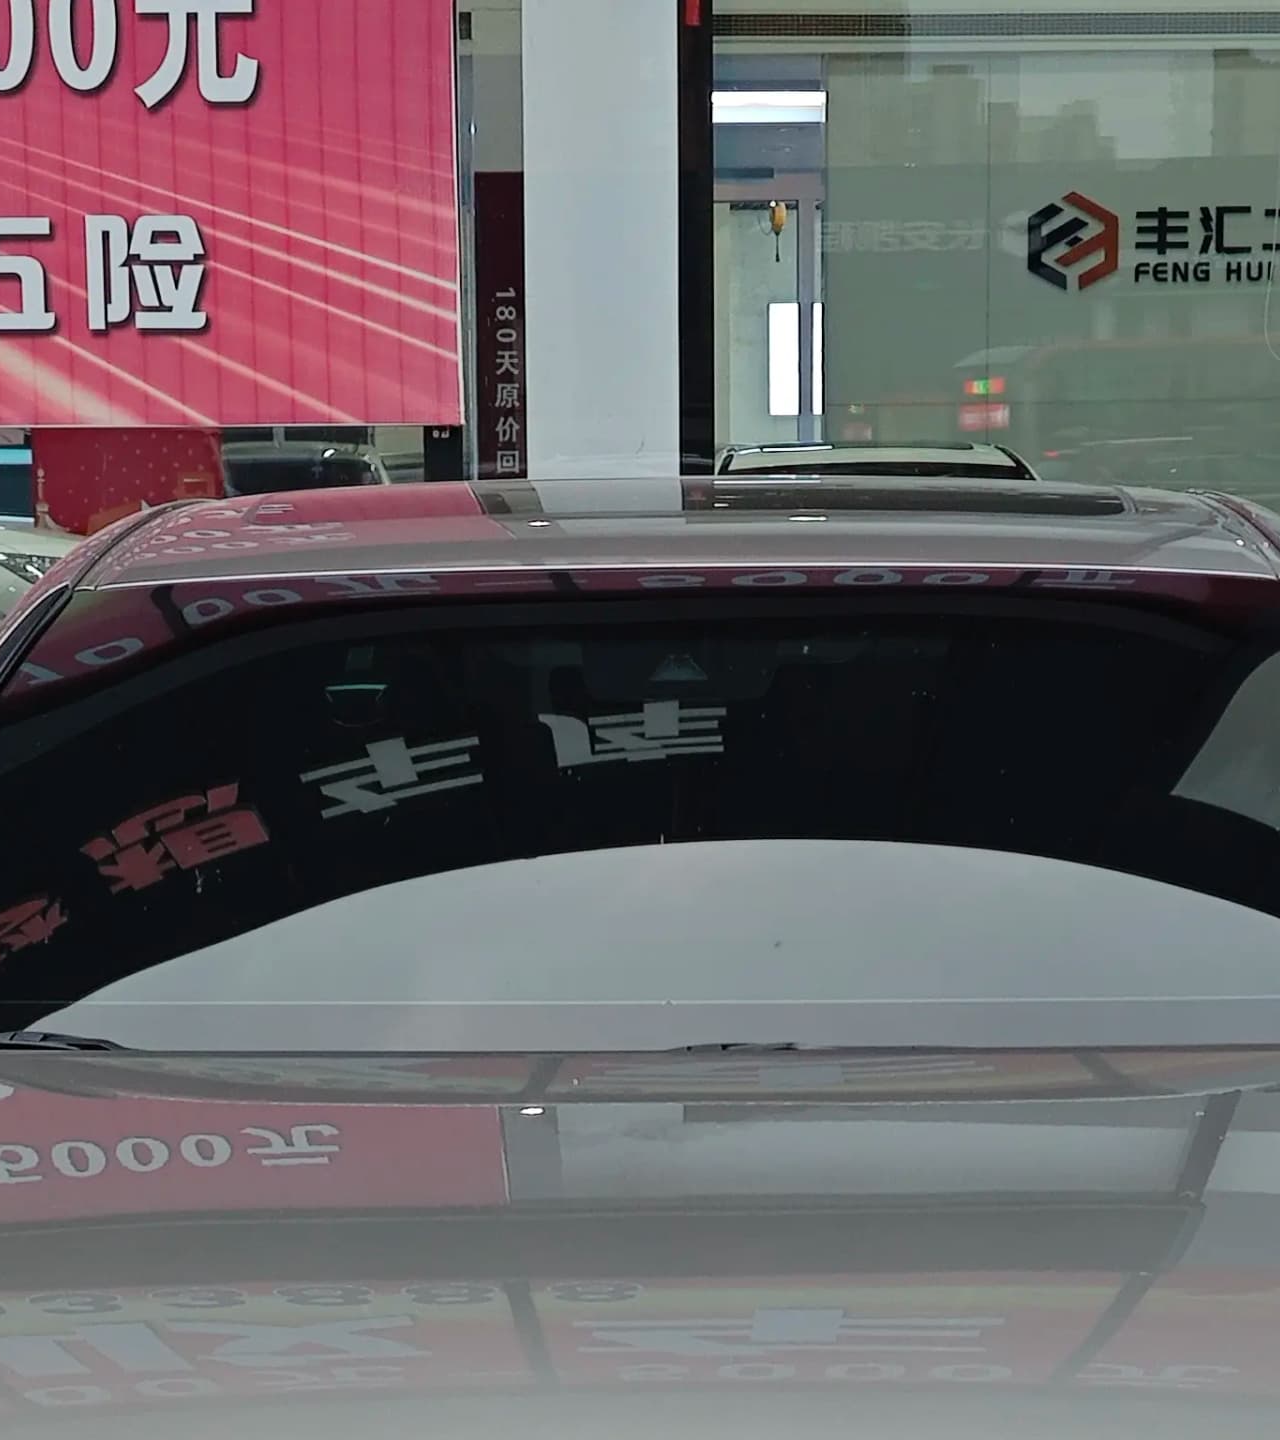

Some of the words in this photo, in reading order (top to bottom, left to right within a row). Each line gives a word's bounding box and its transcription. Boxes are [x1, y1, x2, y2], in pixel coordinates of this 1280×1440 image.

[1134, 261, 1210, 282] FENG
[495, 287, 520, 474] 180天原价回
